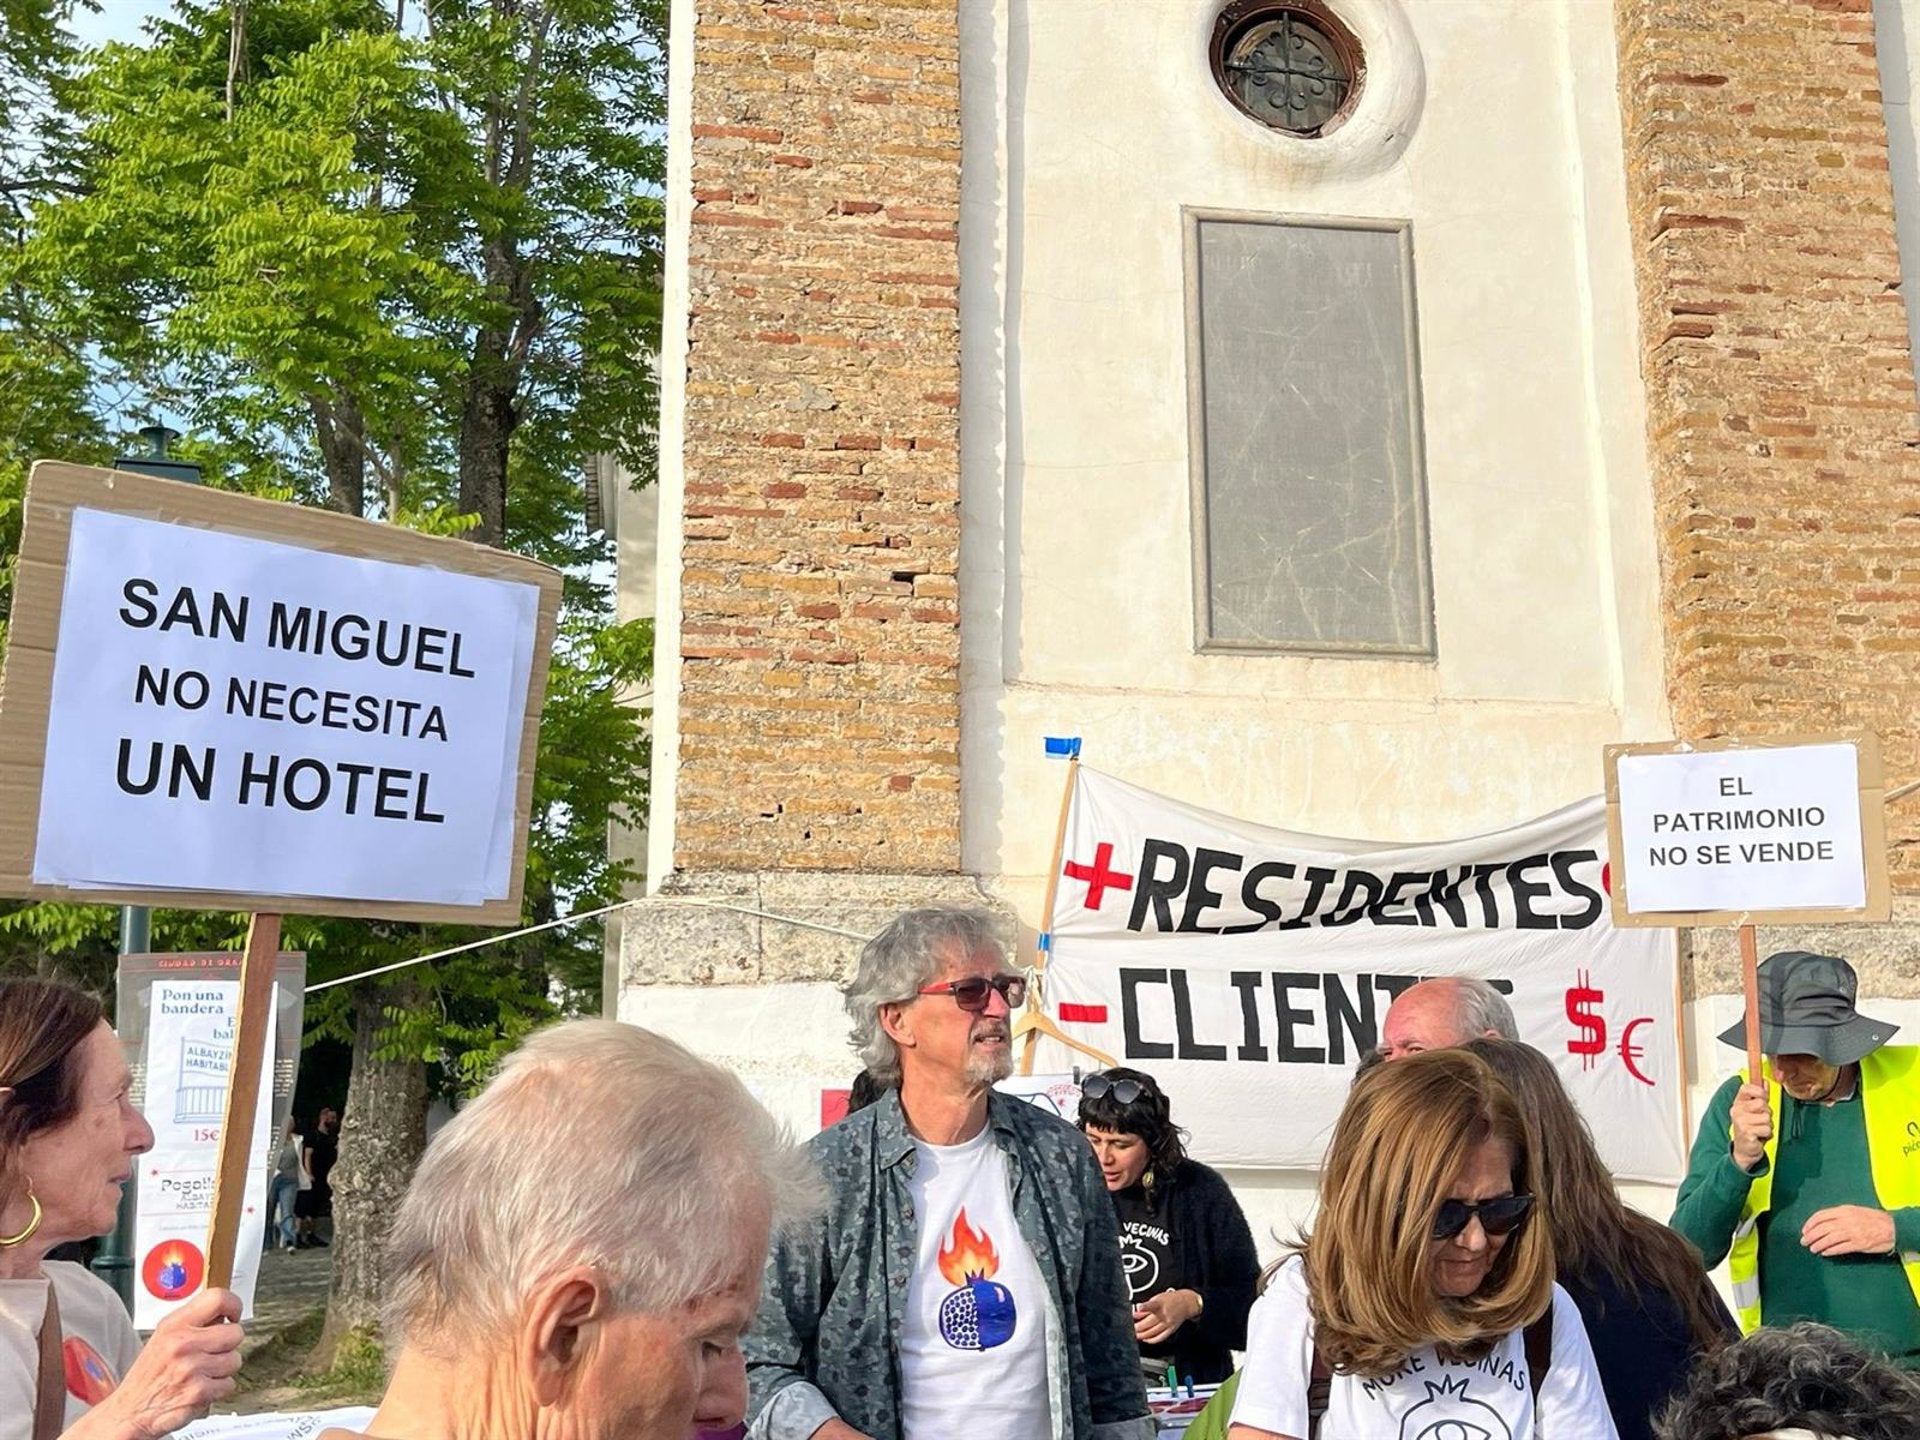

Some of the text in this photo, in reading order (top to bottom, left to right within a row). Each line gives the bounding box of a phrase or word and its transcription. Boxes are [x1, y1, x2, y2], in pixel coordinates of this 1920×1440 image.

[119, 578, 476, 678] SAN MIGUEL
[134, 664, 448, 742] NO NECESITA
[116, 738, 444, 823] UN HOTEL
[1719, 776, 1753, 797] EL
[1653, 806, 1825, 833] PATRIMONIO
[1649, 840, 1834, 866] NO SE VENDE
[1127, 837, 1602, 935] RESIDENTES
[162, 988, 223, 1001] Pon una
[161, 1002, 224, 1014] bandera
[1119, 967, 1513, 1065] CLIEN
[193, 1128, 220, 1142] 15€
[1122, 1221, 1170, 1246] VECINAS
